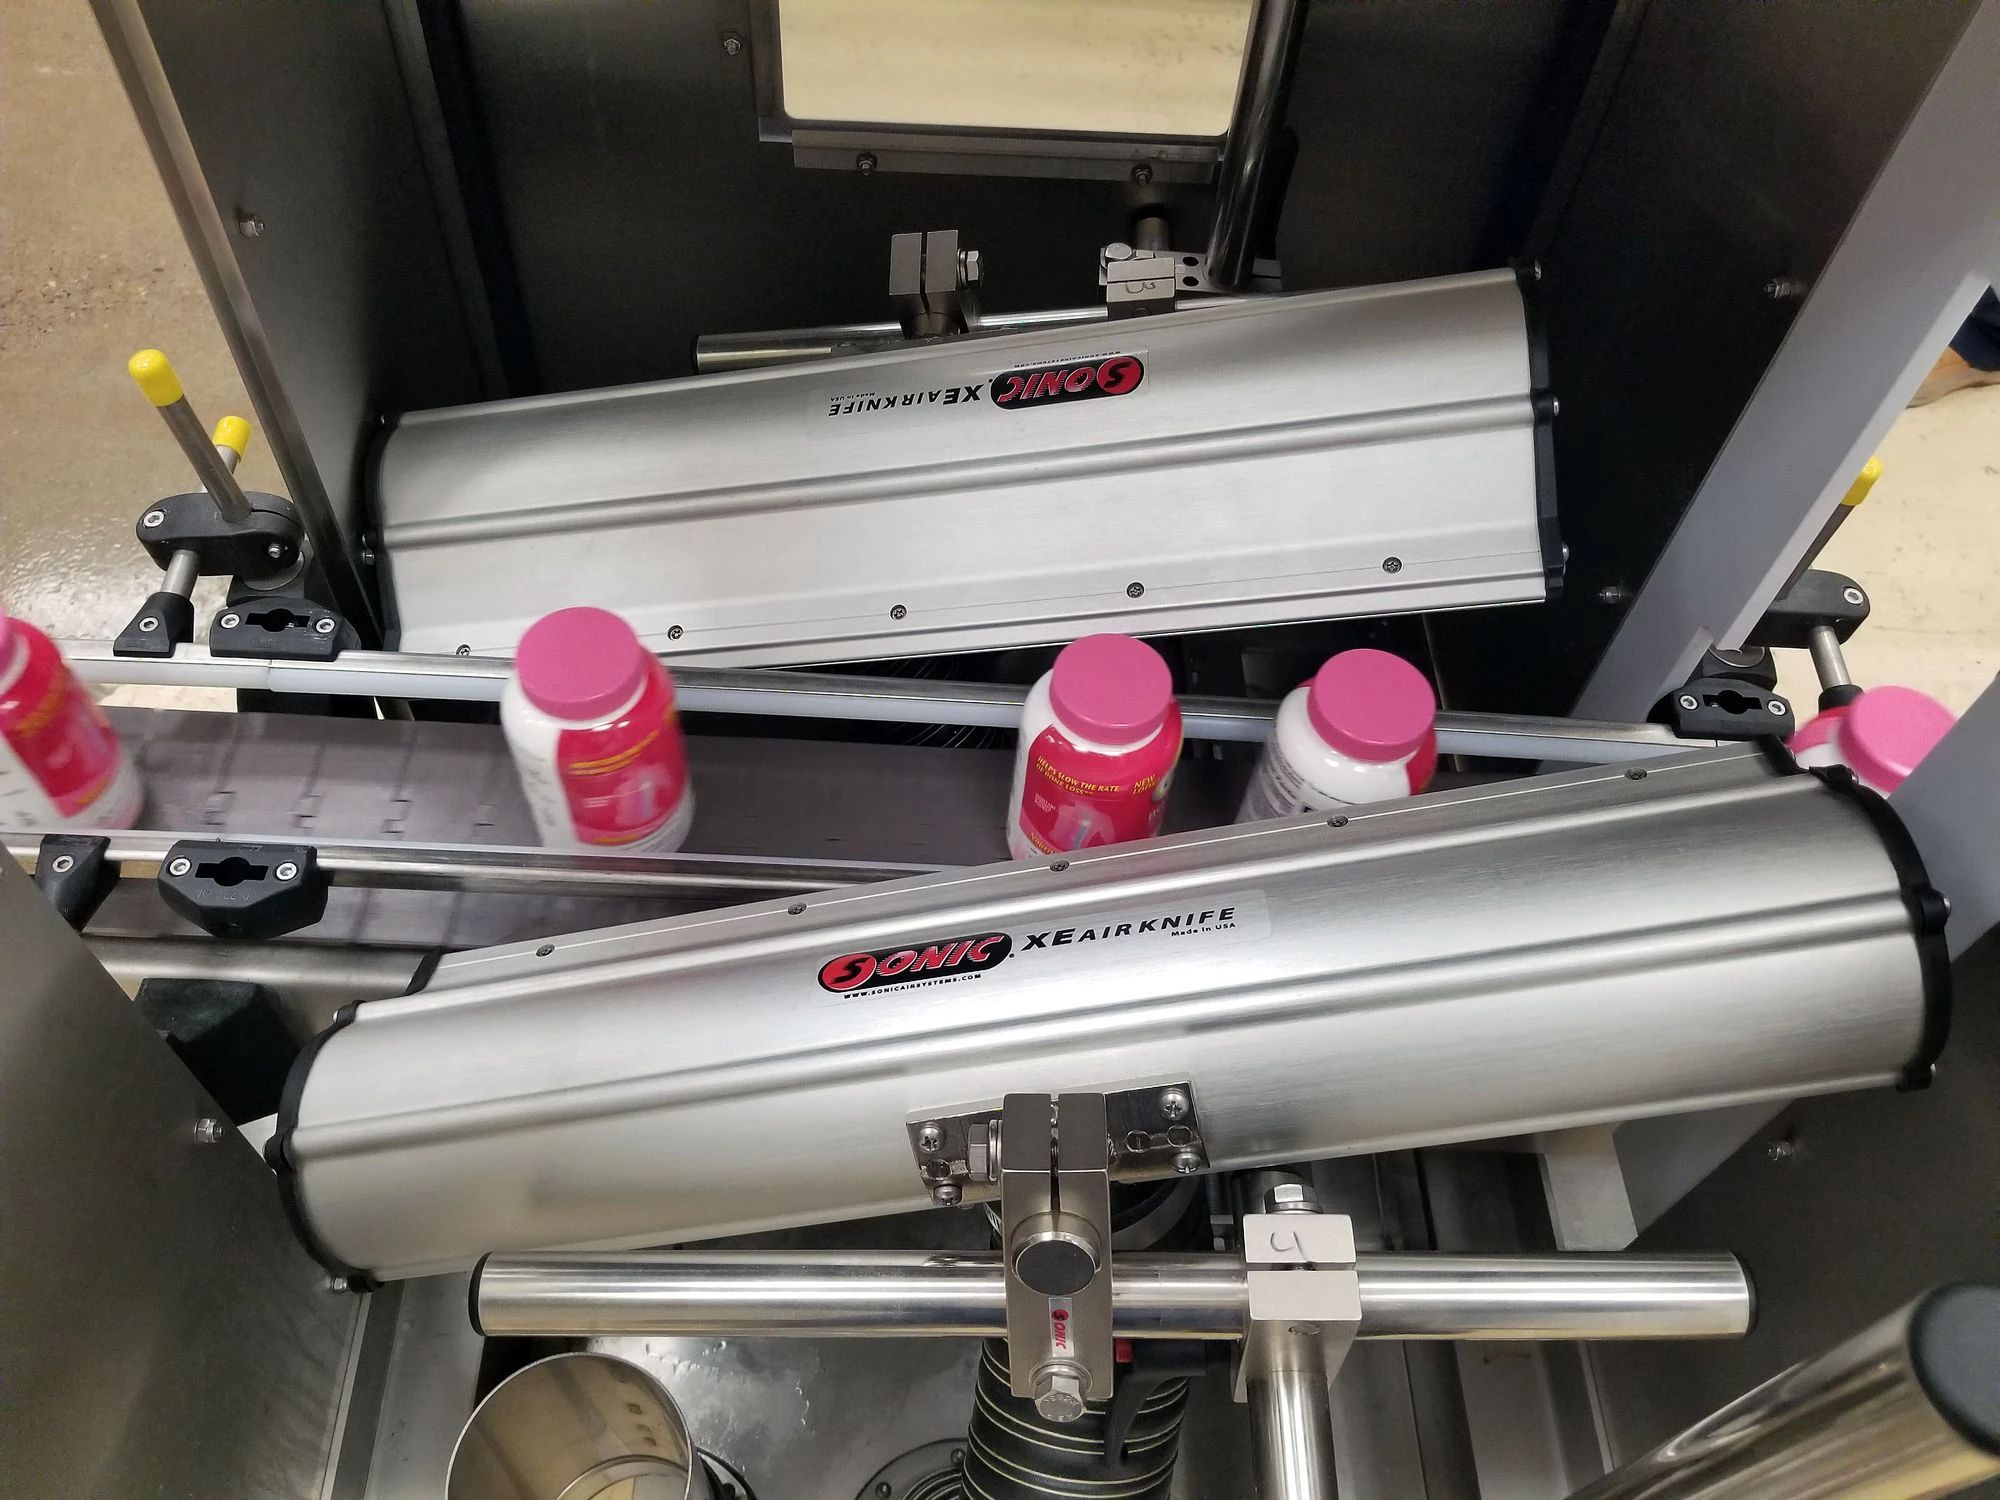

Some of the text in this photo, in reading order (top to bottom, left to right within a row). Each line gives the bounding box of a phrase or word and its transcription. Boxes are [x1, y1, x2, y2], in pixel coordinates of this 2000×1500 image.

[996, 357, 1141, 403] SONIC
[1037, 755, 1120, 793] HELPS SLOW THE RATE
[1133, 773, 1156, 789] NEW
[1171, 928, 1199, 937] Made
[1215, 922, 1236, 930] USA
[821, 935, 1005, 991] SONIC
[843, 974, 982, 1000] WWW.SONICAIRSYSTEMS.COM
[1051, 1309, 1070, 1350] SONIC
